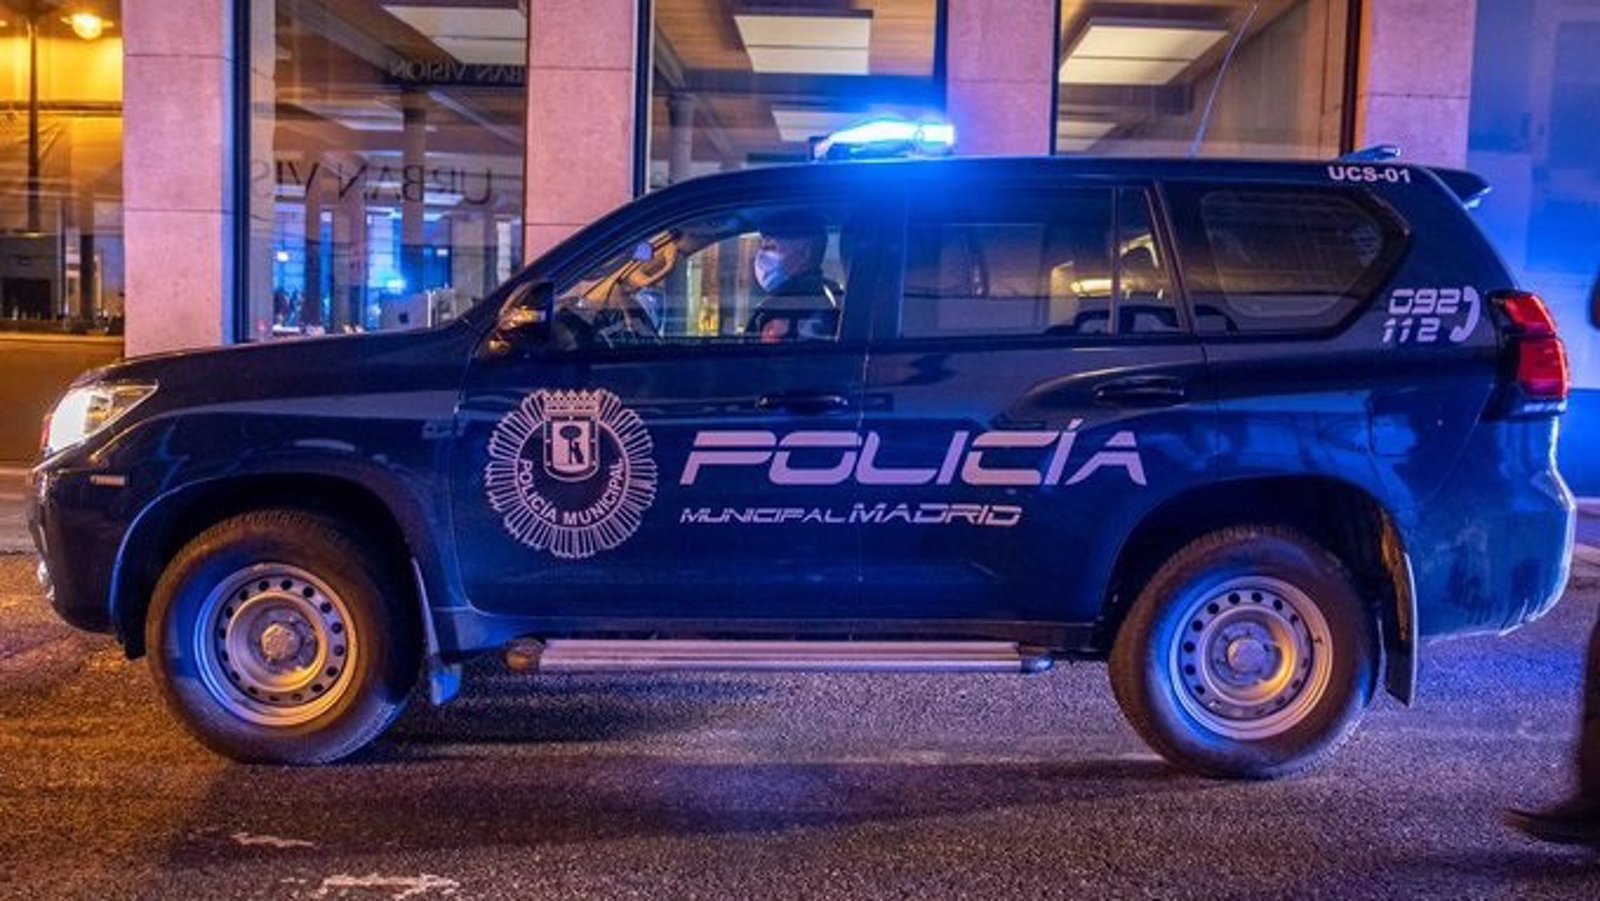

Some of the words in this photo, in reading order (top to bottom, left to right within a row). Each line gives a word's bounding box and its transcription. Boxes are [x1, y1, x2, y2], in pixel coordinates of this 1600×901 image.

[1327, 165, 1411, 183] UCS-01
[1388, 288, 1462, 315] 092
[1382, 317, 1441, 343] 112
[679, 418, 1147, 486] POLICÍA
[562, 457, 625, 526] MUNICIPAL
[679, 507, 846, 523] MUNICIPAL
[849, 502, 1022, 527] MADRID
